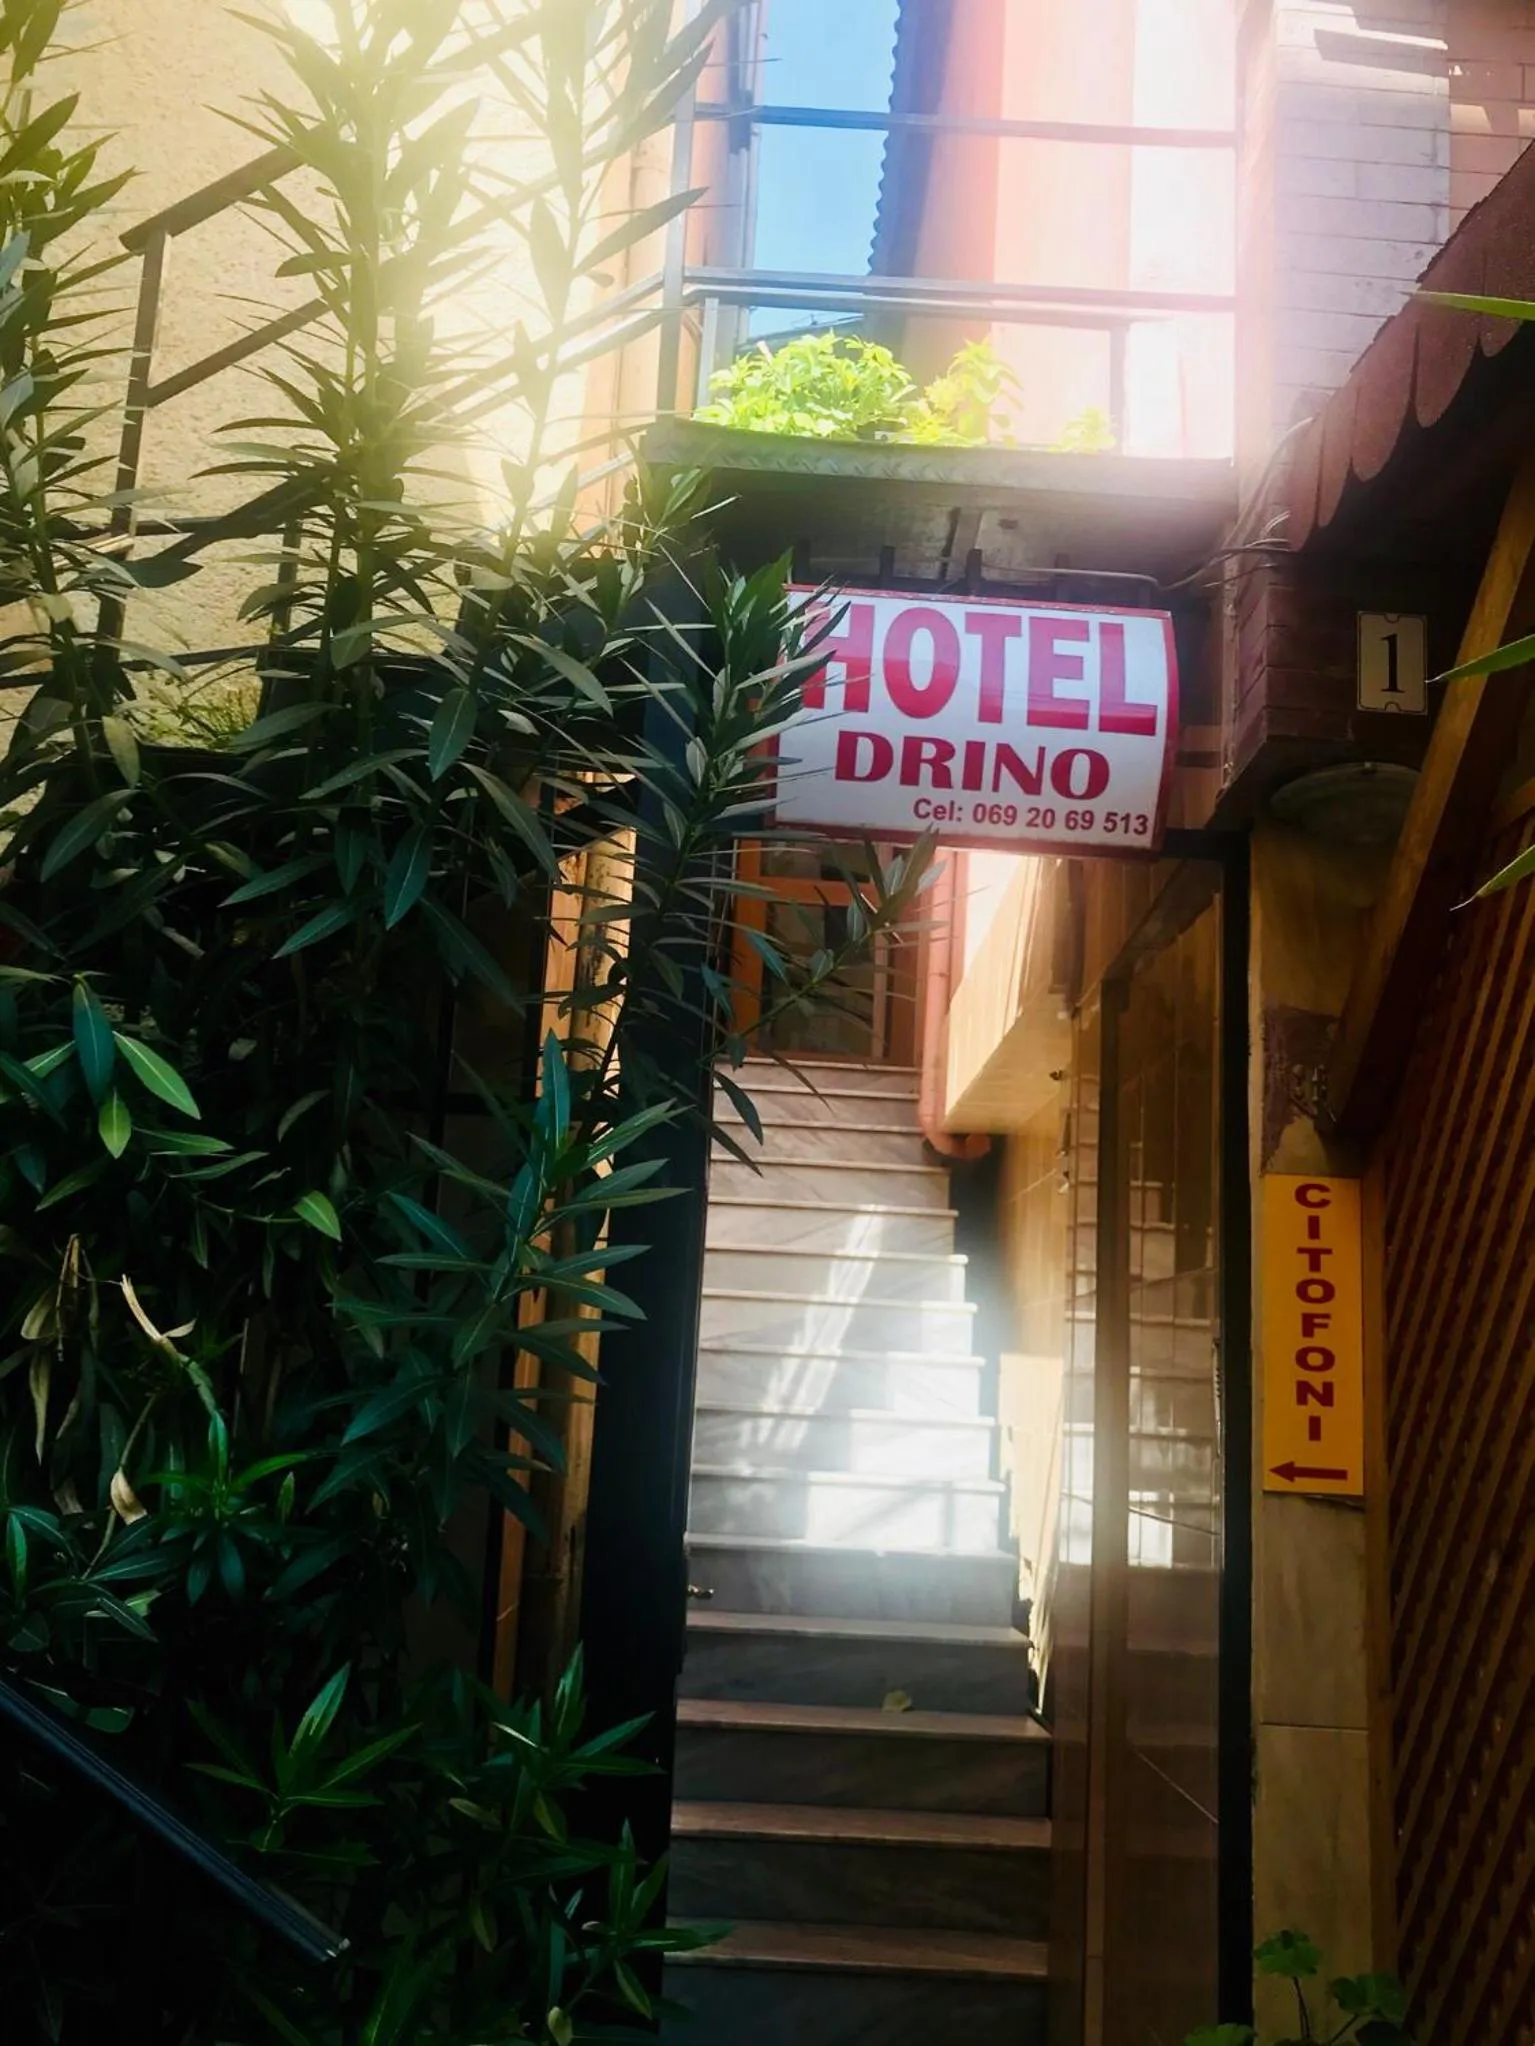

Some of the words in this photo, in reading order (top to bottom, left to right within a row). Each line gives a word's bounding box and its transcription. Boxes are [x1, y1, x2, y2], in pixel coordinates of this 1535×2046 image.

[802, 601, 1158, 736] HOTEL
[1380, 633, 1406, 694] 1
[834, 730, 1111, 801] DRINO
[913, 798, 963, 823] Cel:
[972, 802, 1018, 827] 069
[1025, 806, 1056, 829] 20
[1064, 809, 1095, 831] 69
[1102, 811, 1149, 836] 513
[1294, 1183, 1336, 1442] CITOFONI
